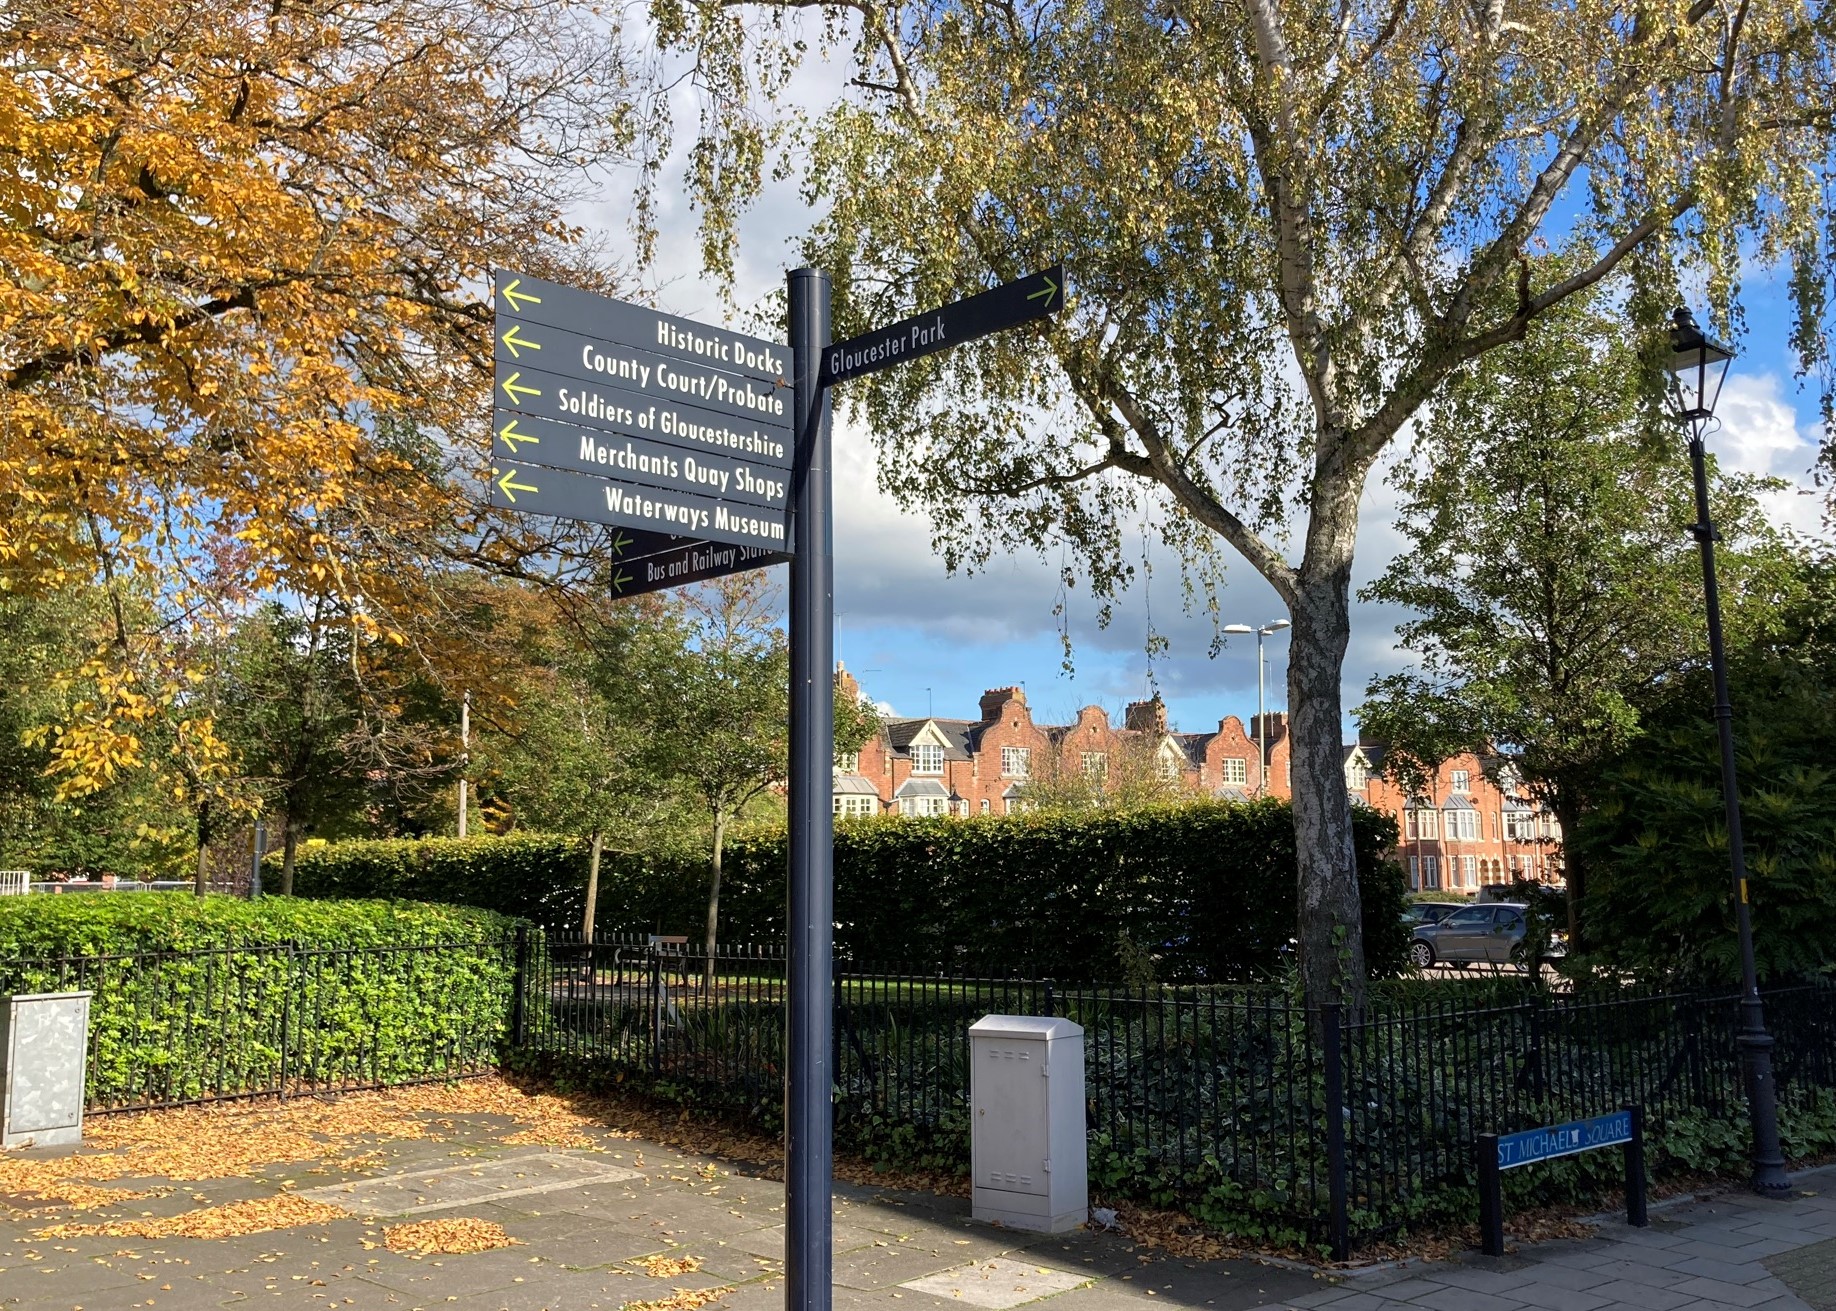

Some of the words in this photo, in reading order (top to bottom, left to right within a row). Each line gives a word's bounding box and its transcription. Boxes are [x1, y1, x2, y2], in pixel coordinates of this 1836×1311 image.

[657, 320, 729, 362] Historic
[734, 341, 783, 376] Docks
[831, 335, 906, 375] Gloucester
[911, 315, 946, 349] Park
[582, 344, 651, 388] County
[657, 363, 783, 416] Court/Probate
[558, 388, 633, 425] Soldiers
[638, 406, 656, 430] of
[660, 411, 784, 459] Gloucestershire
[579, 436, 679, 478] Merchants
[684, 457, 730, 493] Quay
[735, 467, 784, 501] Shops
[605, 486, 709, 531] Waterways
[714, 506, 784, 540] Museum
[647, 562, 665, 583] Bus
[668, 552, 689, 578] and
[692, 545, 736, 572] Railway
[1497, 1142, 1515, 1164] ST
